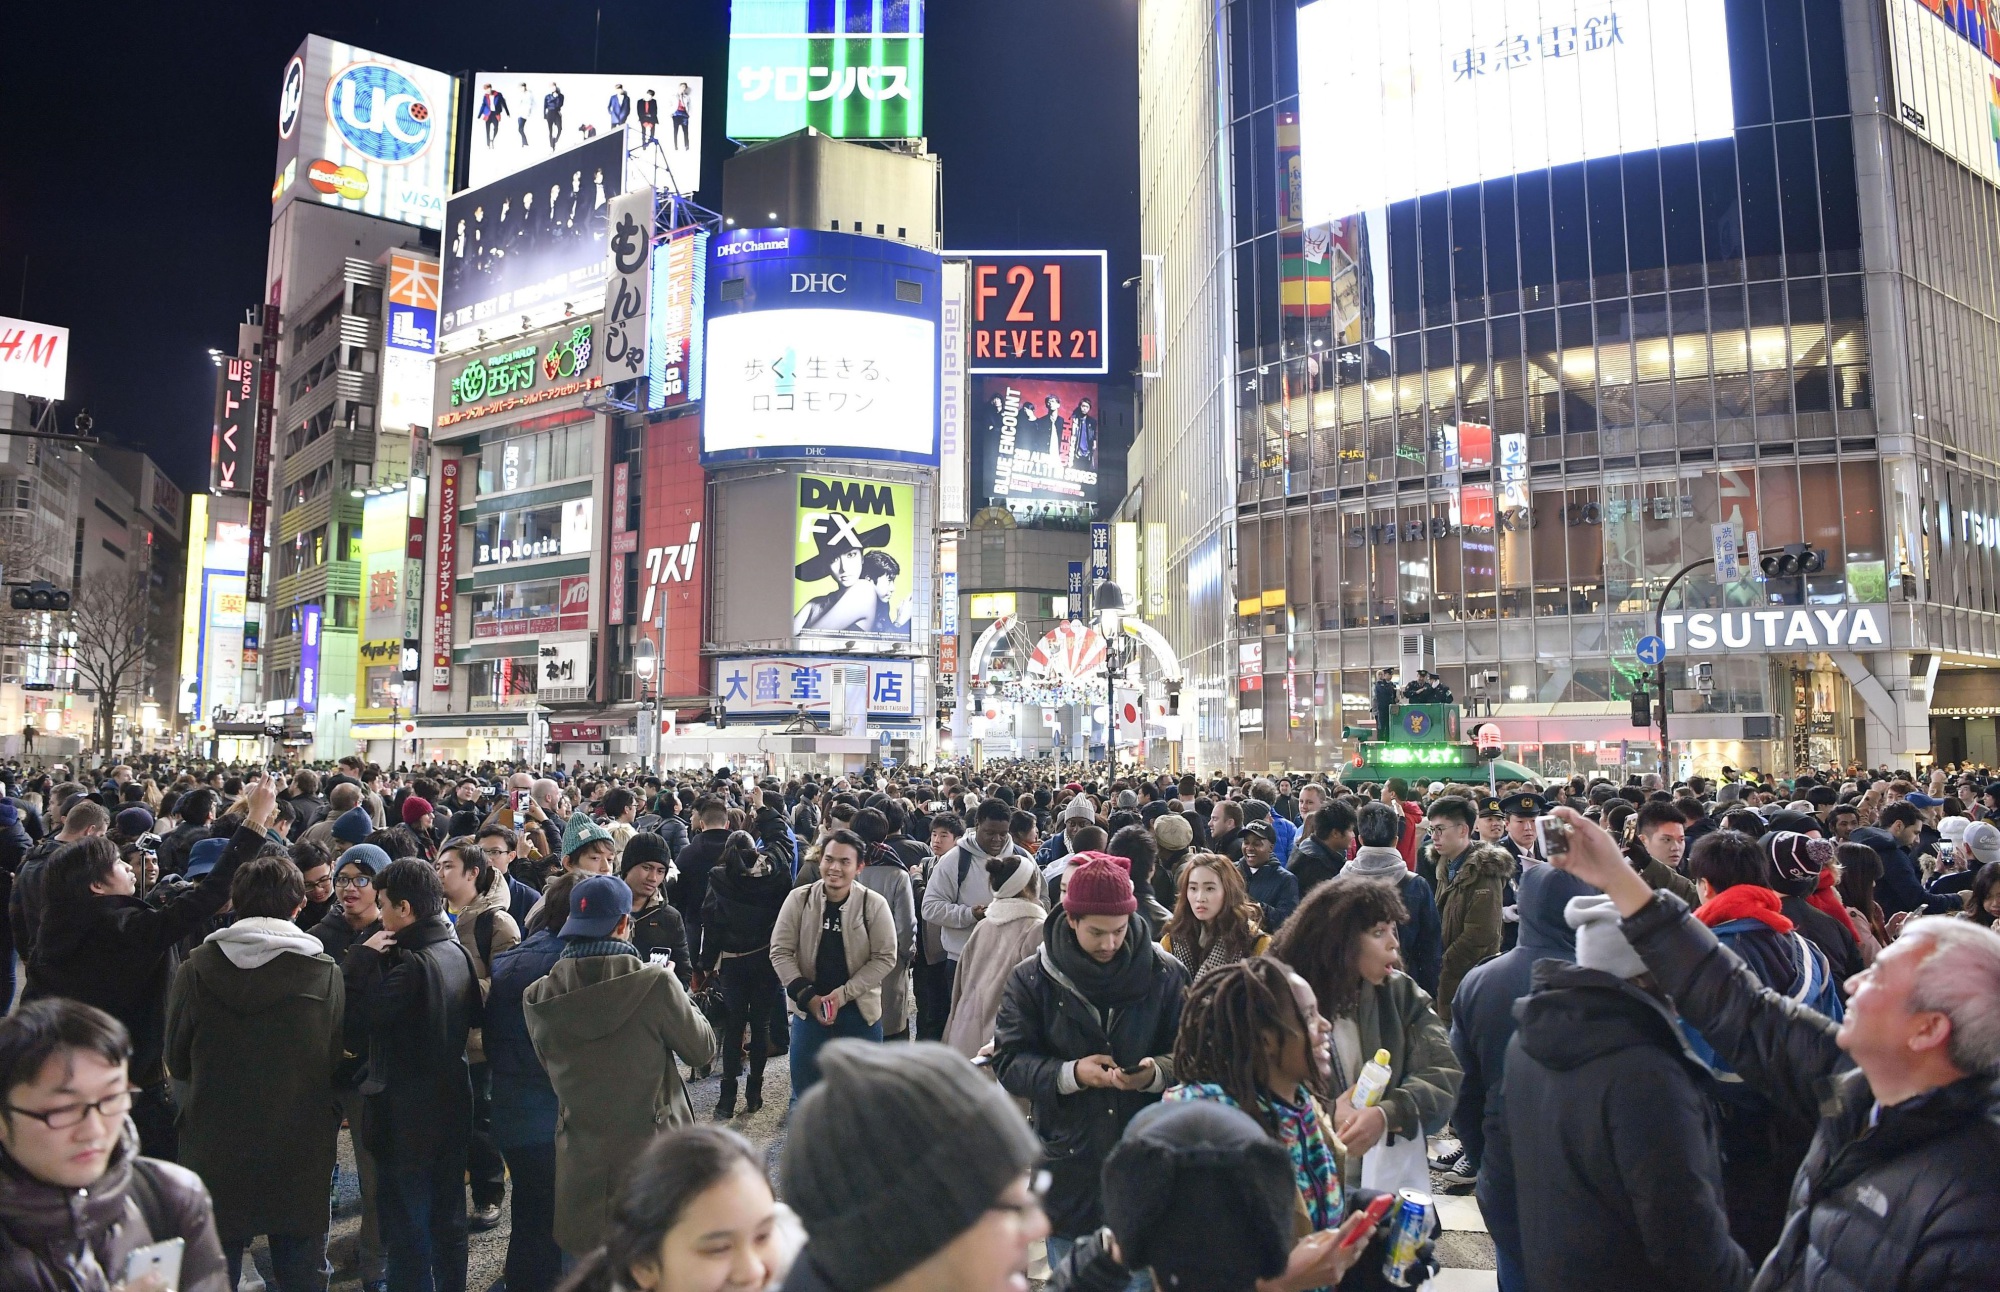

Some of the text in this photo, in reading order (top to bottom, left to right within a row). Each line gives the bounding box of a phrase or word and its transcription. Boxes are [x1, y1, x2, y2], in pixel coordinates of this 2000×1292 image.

[1451, 12, 1624, 83] 東急電鉄
[738, 65, 912, 102] サロンパス
[340, 78, 427, 144] UC
[401, 190, 442, 212] VISA
[717, 237, 789, 257] DHC Channel
[391, 259, 437, 307] 本
[605, 212, 650, 374] もんじゃ
[790, 273, 847, 294] DHC
[975, 264, 1061, 322] F21
[456, 305, 473, 326] THE
[662, 243, 687, 397] 三千里薬品
[0, 328, 58, 368] H&M
[1070, 329, 1097, 358] 21
[241, 360, 253, 400] TOKYO
[487, 358, 536, 397] 西村
[943, 293, 962, 455] Taisei neon
[753, 391, 874, 413] ロコモワン
[805, 447, 826, 456] DHC
[994, 386, 1021, 495] BLUE ENCOUNT
[800, 477, 895, 517] DMM
[440, 488, 455, 602] ウィンターフルーツギフト
[479, 535, 558, 564] Euphoria
[799, 512, 863, 548] FX
[1722, 526, 1736, 579] 渋谷駅前
[370, 570, 399, 613] 薬
[562, 581, 589, 608] JTB
[1661, 608, 1883, 650] TSUTAYA
[725, 667, 904, 703] 大盛堂店
[1380, 747, 1461, 764] お願いします。
